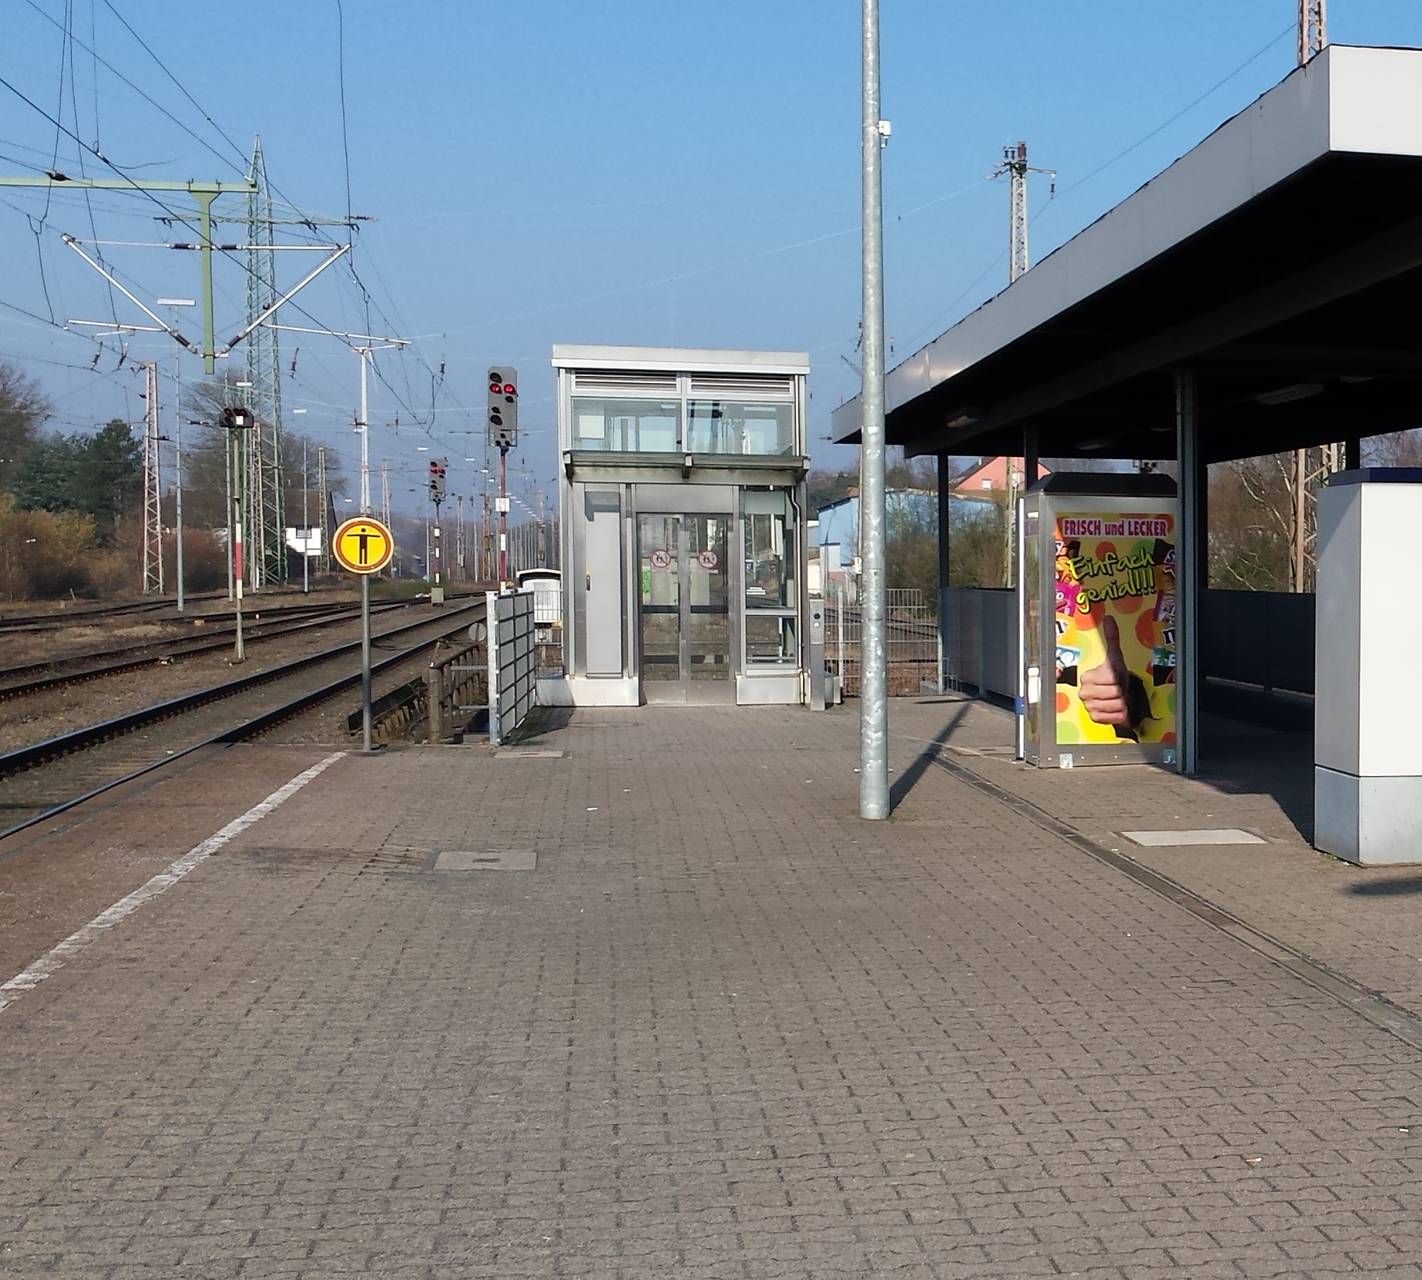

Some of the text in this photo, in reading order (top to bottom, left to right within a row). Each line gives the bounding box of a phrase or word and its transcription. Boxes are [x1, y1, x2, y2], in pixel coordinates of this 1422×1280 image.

[1064, 519, 1167, 537] FRISCH und LECKER
[1068, 547, 1155, 580] Einfach
[1076, 566, 1155, 613] genial!!!
